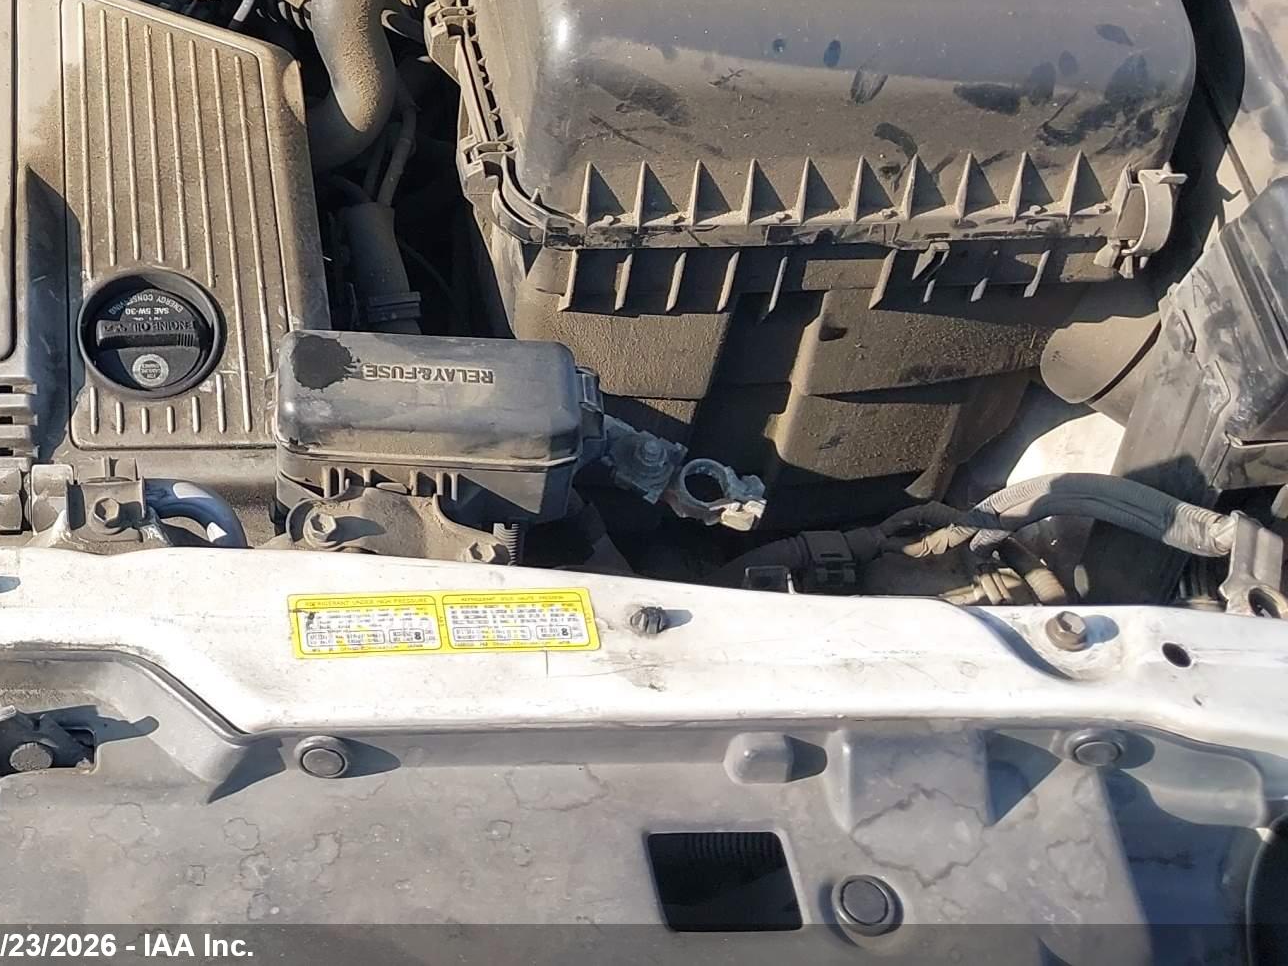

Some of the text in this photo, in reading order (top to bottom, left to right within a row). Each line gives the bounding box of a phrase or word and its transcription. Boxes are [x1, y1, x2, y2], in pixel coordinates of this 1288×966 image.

[124, 307, 170, 315] SAE 5W-30
[155, 296, 184, 313] ENERGY
[363, 363, 494, 384] RELAY&FUSE
